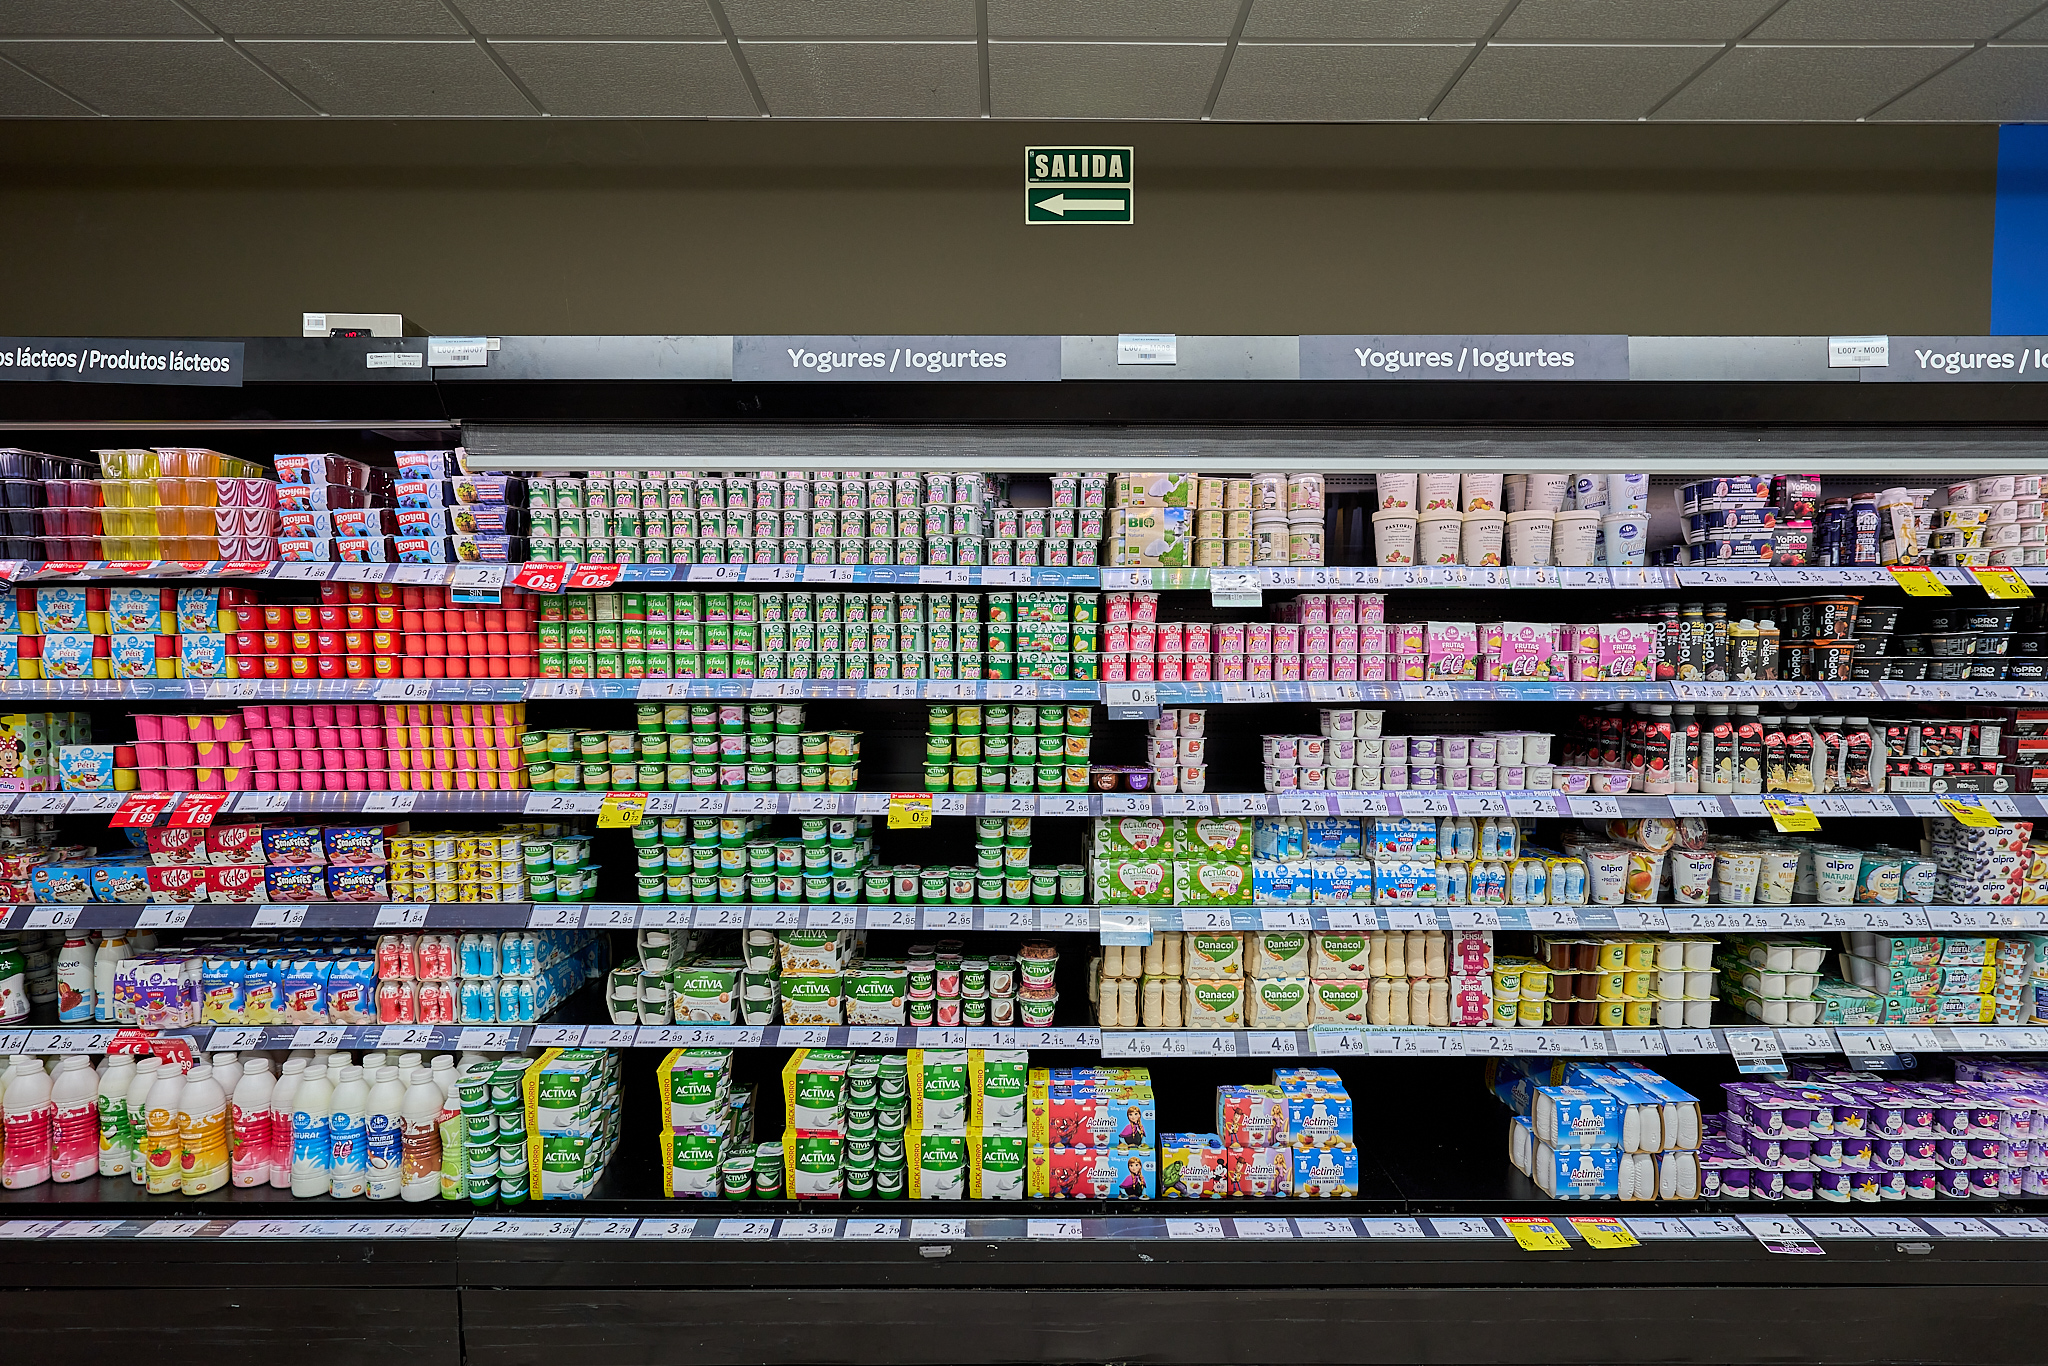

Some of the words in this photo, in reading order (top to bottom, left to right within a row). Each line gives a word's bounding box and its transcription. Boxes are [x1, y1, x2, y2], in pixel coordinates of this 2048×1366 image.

[1035, 154, 1124, 179] SALIDA
[1837, 347, 1856, 355] L007
[1863, 346, 1885, 354] M009
[16, 347, 77, 368] lácteos
[89, 353, 166, 373] Produtos
[169, 351, 230, 374] lácteos
[787, 349, 886, 373] Yogures
[905, 349, 1007, 373] Iogurtes
[1354, 347, 1454, 373] Yogures
[1473, 347, 1575, 373] Iogurtes
[1914, 348, 2015, 374] Yogures
[276, 455, 306, 469] Royal
[398, 453, 425, 466] Royal
[1790, 482, 1817, 493] YoPRO
[282, 512, 312, 526] Royal
[1128, 518, 1155, 528] BIO
[1776, 535, 1808, 545] YoPRO
[398, 540, 426, 552] Royal
[2011, 666, 2043, 674] YoPRO
[1989, 828, 2013, 837] alpro
[163, 831, 188, 846] KitKat
[1601, 865, 1623, 873] alpro
[1690, 862, 1713, 871] alpro
[1826, 861, 1853, 871] alpro
[163, 870, 190, 886] KitKat
[223, 869, 249, 886] KitKat
[1198, 940, 1234, 950] Danacol
[1267, 939, 1300, 949] Danacol
[684, 979, 722, 989] ACTIVIA
[791, 984, 829, 994] ACTIVIA
[856, 984, 893, 994] ACTIVIA
[1199, 990, 1235, 1000] Danacol
[1264, 990, 1300, 999] Danacol
[1322, 990, 1358, 999] Danacol
[540, 1089, 577, 1098] ACTIVIA
[1087, 1117, 1117, 1128] Actimel
[1571, 1117, 1604, 1128] Actimel
[678, 1151, 714, 1161] ACTIVIA
[984, 1152, 1019, 1161] ACTIVIA
[1309, 1165, 1344, 1176] Actimel
